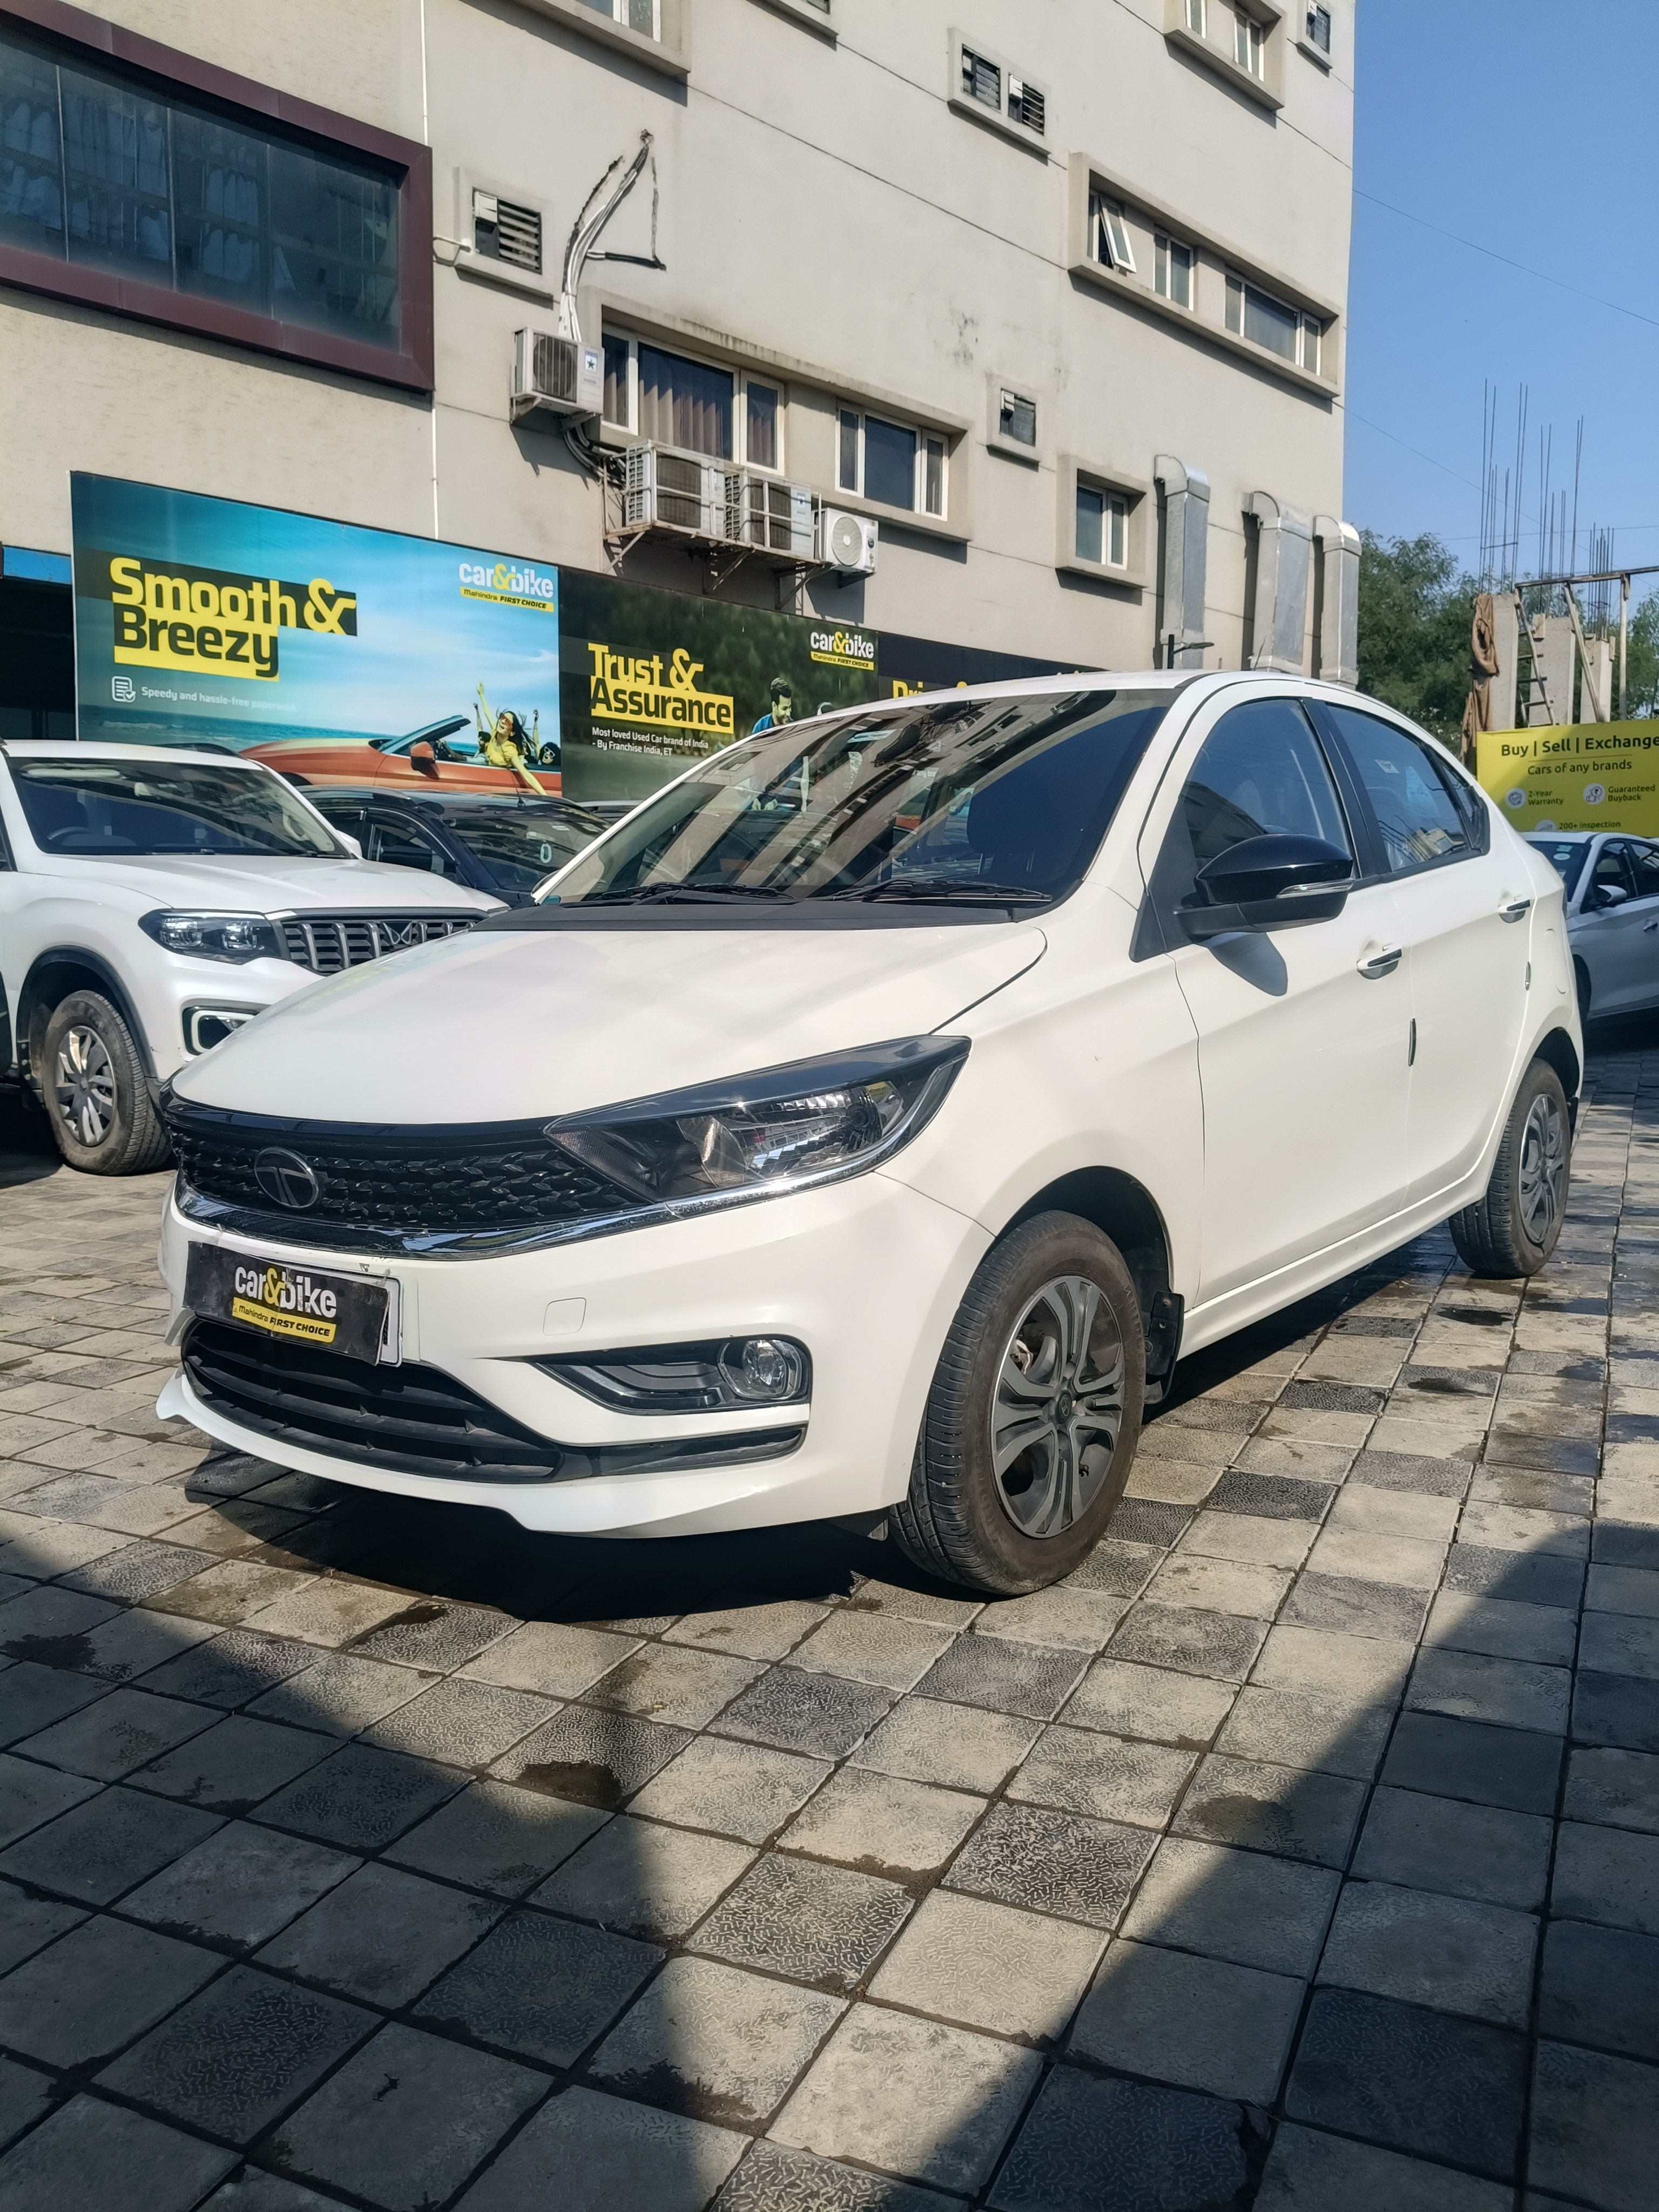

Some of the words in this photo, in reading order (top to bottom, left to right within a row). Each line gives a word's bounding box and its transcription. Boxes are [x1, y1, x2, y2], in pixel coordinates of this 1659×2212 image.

[459, 563, 554, 598] car&bike
[110, 557, 296, 628] Smooth
[304, 578, 356, 635] &
[464, 589, 497, 601] Mahindra
[500, 596, 521, 605] FIRST
[522, 599, 547, 609] CHOICE
[113, 603, 279, 678] Breezy
[811, 631, 874, 659] car&bike
[588, 643, 664, 686] Trust
[669, 648, 704, 692] &
[141, 686, 178, 702] Speedy
[179, 691, 197, 702] and
[199, 693, 249, 707] hassle-free
[589, 677, 731, 728] Assurance
[592, 727, 611, 737] Most
[612, 729, 631, 740] loved
[632, 732, 650, 742] Used
[651, 734, 663, 744] Car
[664, 736, 683, 746] brand
[684, 738, 692, 746] of
[692, 739, 709, 749] India
[597, 739, 608, 751] By
[609, 741, 643, 753] Franchise
[644, 745, 663, 756] India,
[664, 748, 673, 756] ET
[1501, 744, 1529, 758] Buy
[1542, 738, 1571, 753] Sell
[1585, 735, 1659, 750] Exchange
[1527, 765, 1552, 775] Cars
[1555, 763, 1567, 773] of
[1569, 764, 1589, 774] any
[1593, 759, 1632, 771] brands
[1608, 784, 1656, 793] Guaranteed
[1608, 793, 1642, 802] Buyback
[1528, 797, 1564, 805] Warranty
[1579, 820, 1621, 830] inspection
[235, 1266, 337, 1318] car&bike
[239, 1305, 268, 1321] Mahindra
[270, 1317, 295, 1328] FIRST
[295, 1323, 331, 1336] CHOICE
